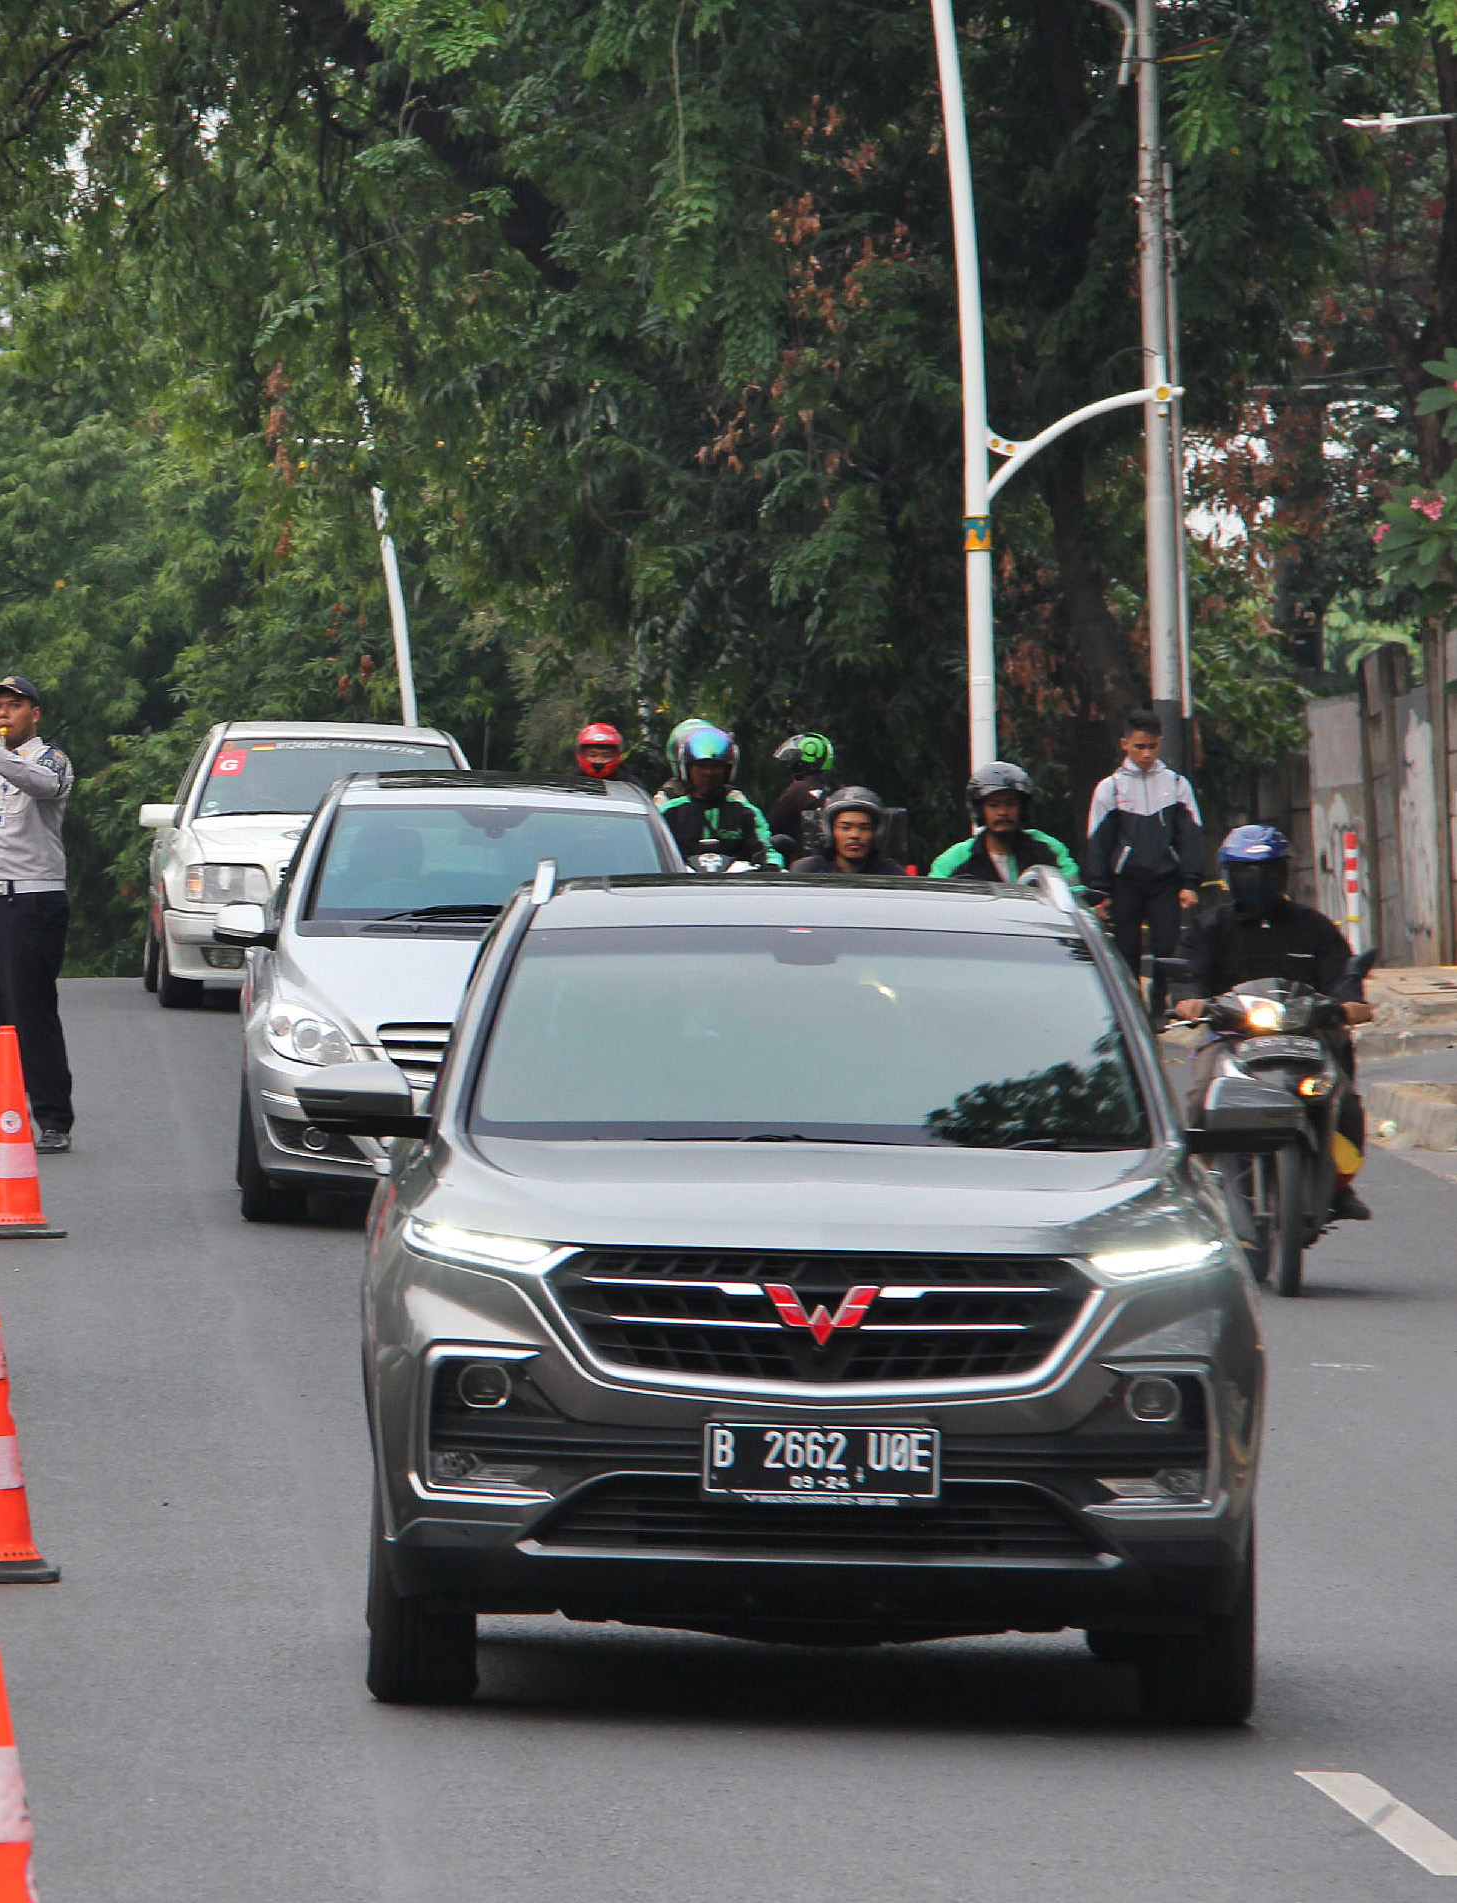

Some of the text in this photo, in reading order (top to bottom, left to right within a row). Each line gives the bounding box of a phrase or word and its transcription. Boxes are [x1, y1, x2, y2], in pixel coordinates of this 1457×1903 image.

[219, 759, 239, 771] G
[712, 1429, 735, 1468] B
[763, 1431, 848, 1471] 2662
